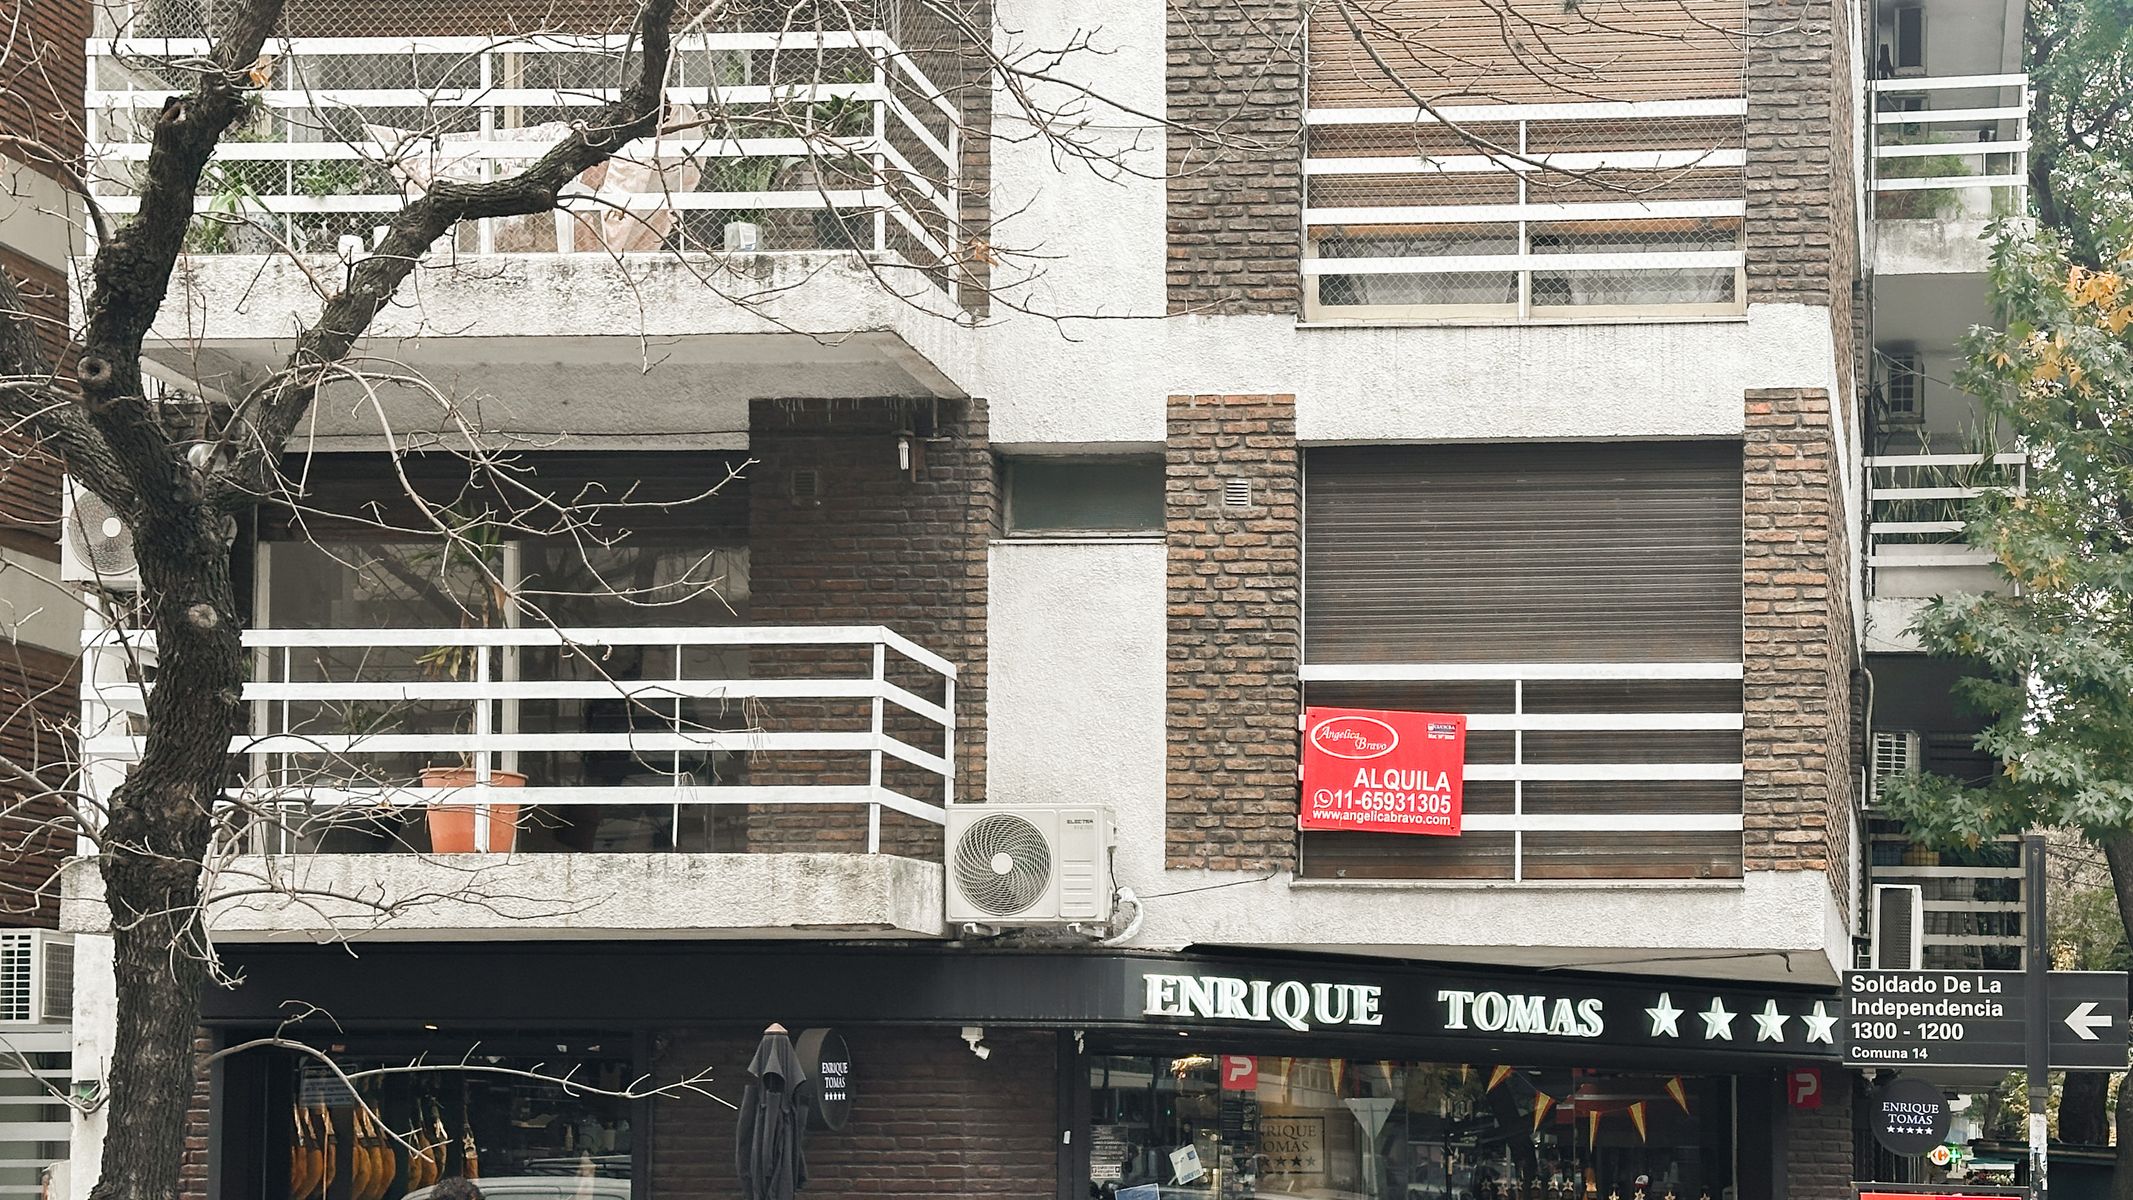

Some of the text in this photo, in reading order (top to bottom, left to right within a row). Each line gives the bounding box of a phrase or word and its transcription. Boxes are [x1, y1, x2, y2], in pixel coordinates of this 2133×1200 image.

[1316, 726, 1360, 741] Angelica
[1355, 737, 1387, 750] Bravo
[1353, 767, 1451, 792] ALQUILA
[1334, 789, 1451, 814] 11-65931305
[1312, 809, 1451, 826] www.angelicabravo.com
[1851, 975, 2002, 993] Soldado De La
[1143, 973, 1604, 1037] ENRIQUE TOMAS
[1851, 997, 2003, 1020] Independencia
[1851, 1022, 1897, 1039] 1300
[1917, 1022, 1964, 1040] 1200
[1851, 1046, 1928, 1059] Comuna 14
[821, 1062, 848, 1076] ENRIQUE
[824, 1077, 846, 1088] TOMAS
[1882, 1101, 1939, 1115] ENRIQUE
[1888, 1113, 1933, 1125] TOMAS
[1261, 1125, 1317, 1140] RIQUE
[1263, 1141, 1310, 1152] OMAS
